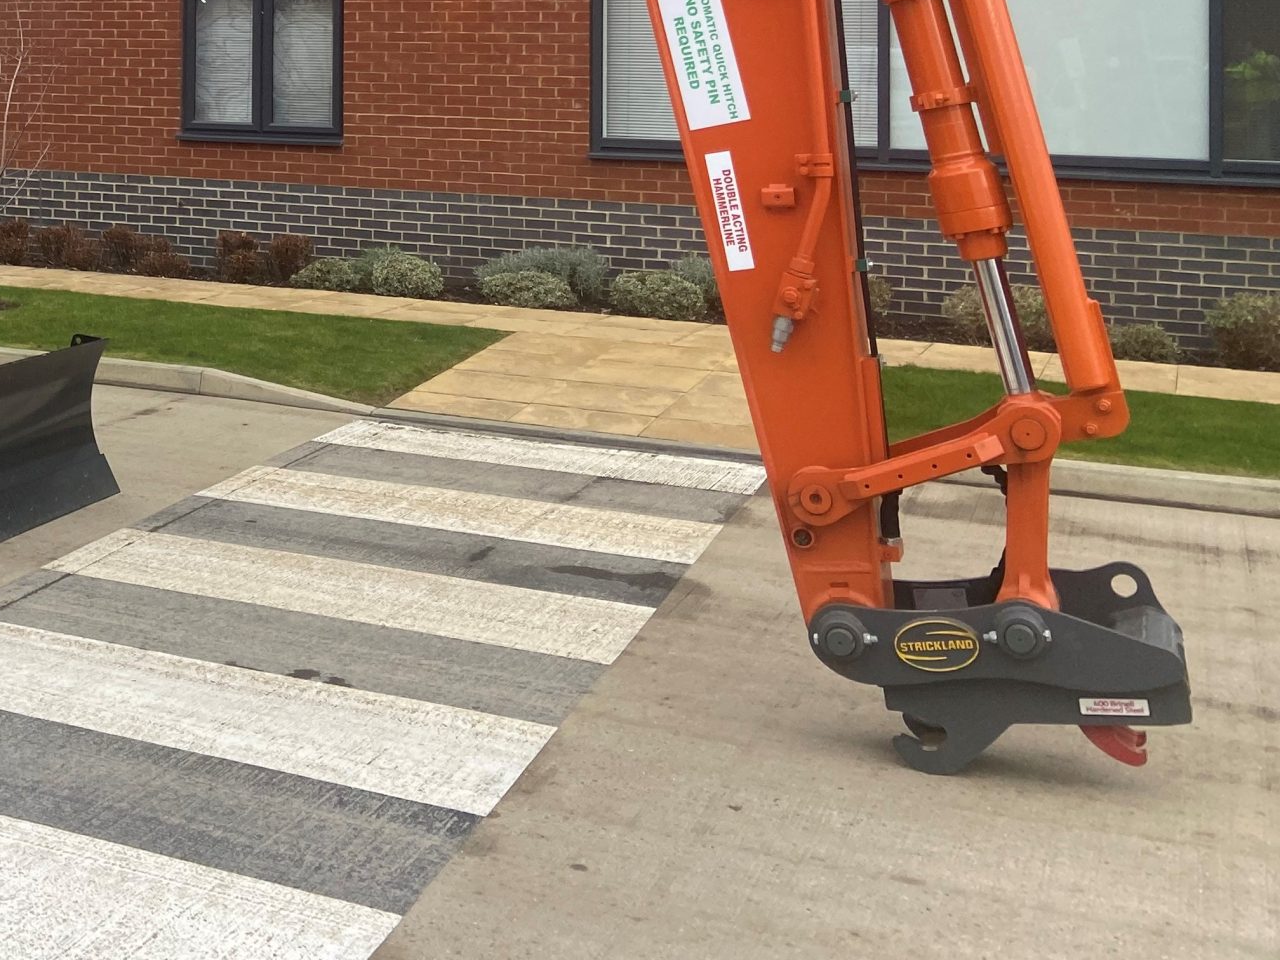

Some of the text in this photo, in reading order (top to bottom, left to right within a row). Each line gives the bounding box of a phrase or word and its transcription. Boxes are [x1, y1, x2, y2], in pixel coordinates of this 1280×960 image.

[673, 16, 701, 90] REQUIRED
[690, 20, 714, 76] SAFETY
[705, 79, 721, 106] PIN
[712, 43, 729, 81] QUICK
[722, 82, 739, 120] HITCH
[713, 178, 736, 247] HAMMERLINE
[722, 169, 748, 253] DOUBLE ACTING
[900, 639, 974, 652] STRICKLAND
